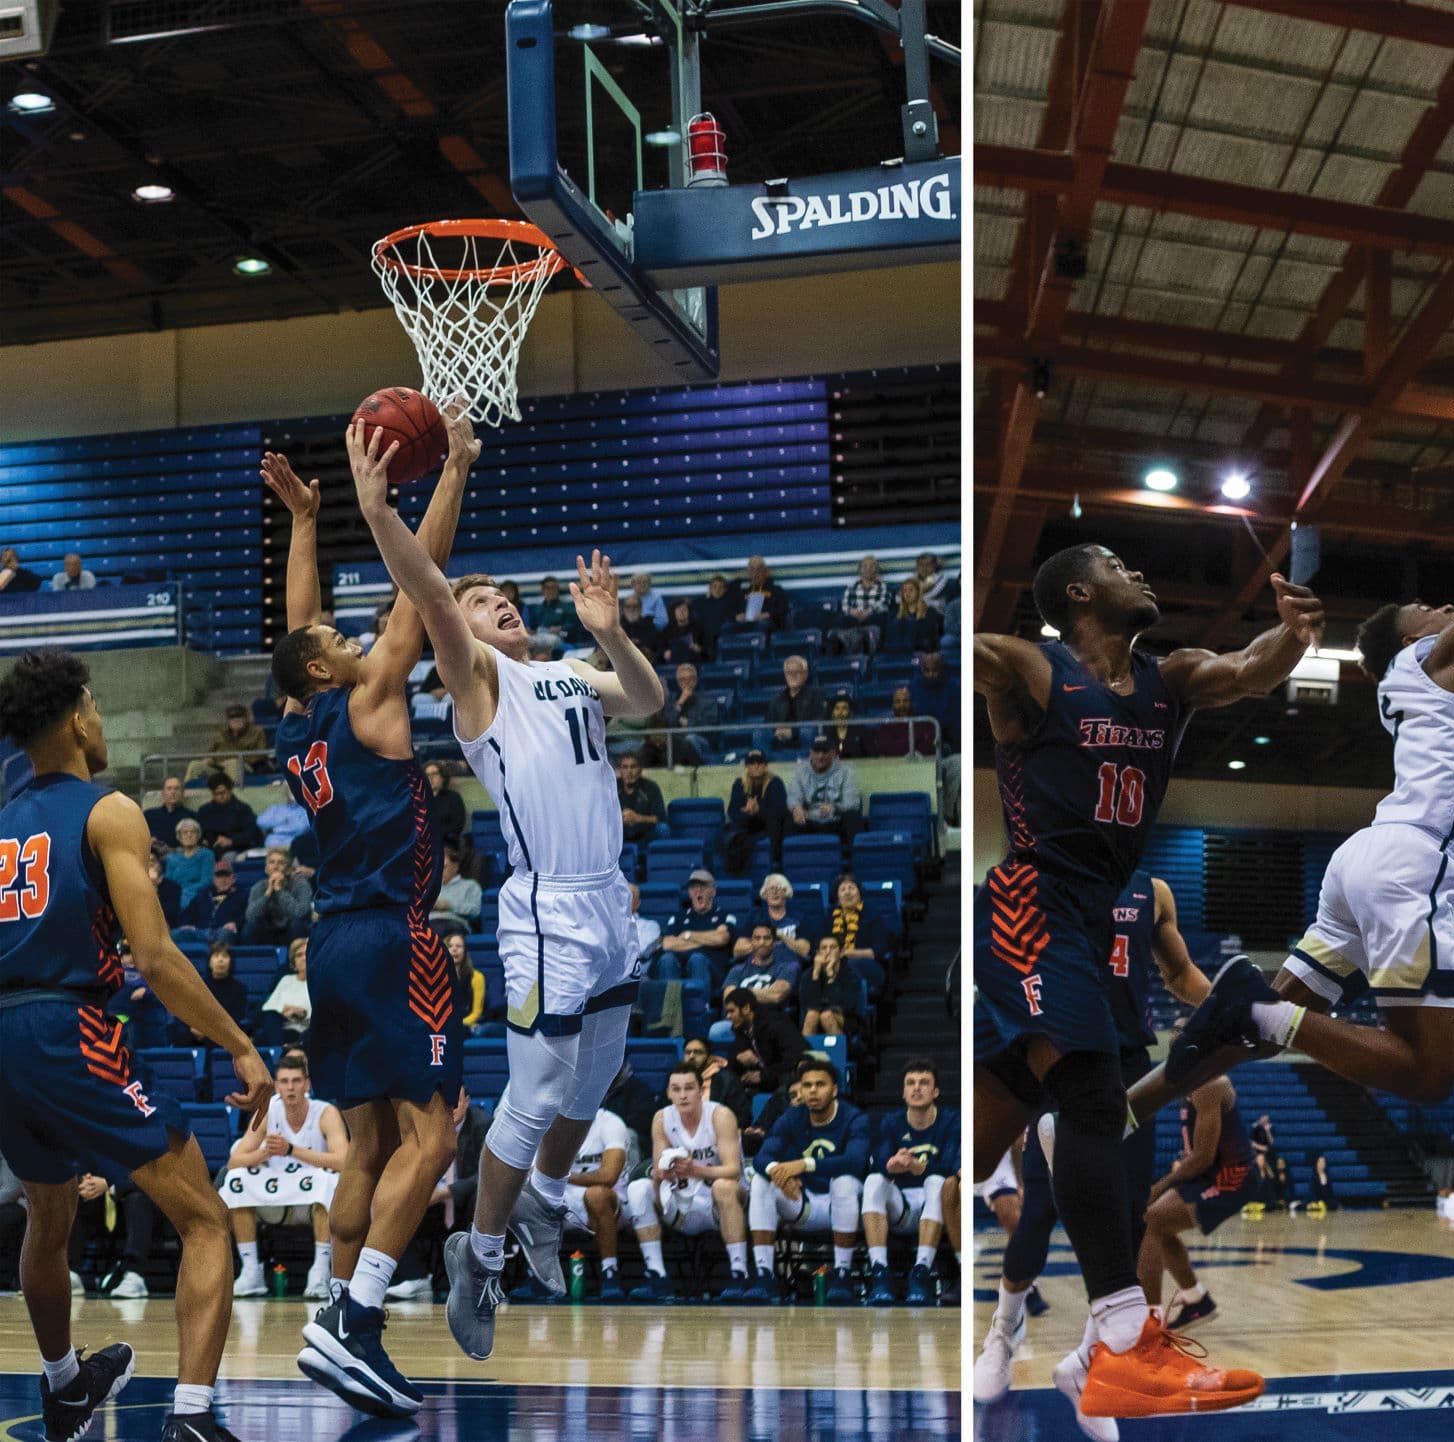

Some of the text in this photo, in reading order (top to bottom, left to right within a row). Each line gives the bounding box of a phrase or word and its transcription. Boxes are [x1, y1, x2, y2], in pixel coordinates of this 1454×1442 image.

[751, 173, 951, 240] SPALDING
[147, 592, 170, 605] 210
[338, 573, 360, 585] 211
[533, 679, 558, 701] UC
[1080, 718, 1165, 749] TITANS
[287, 740, 334, 816] 13
[1094, 762, 1147, 827] 10
[0, 831, 51, 922] 23
[1109, 934, 1130, 977] 4
[1020, 973, 1044, 1016] F
[429, 1034, 447, 1066] F
